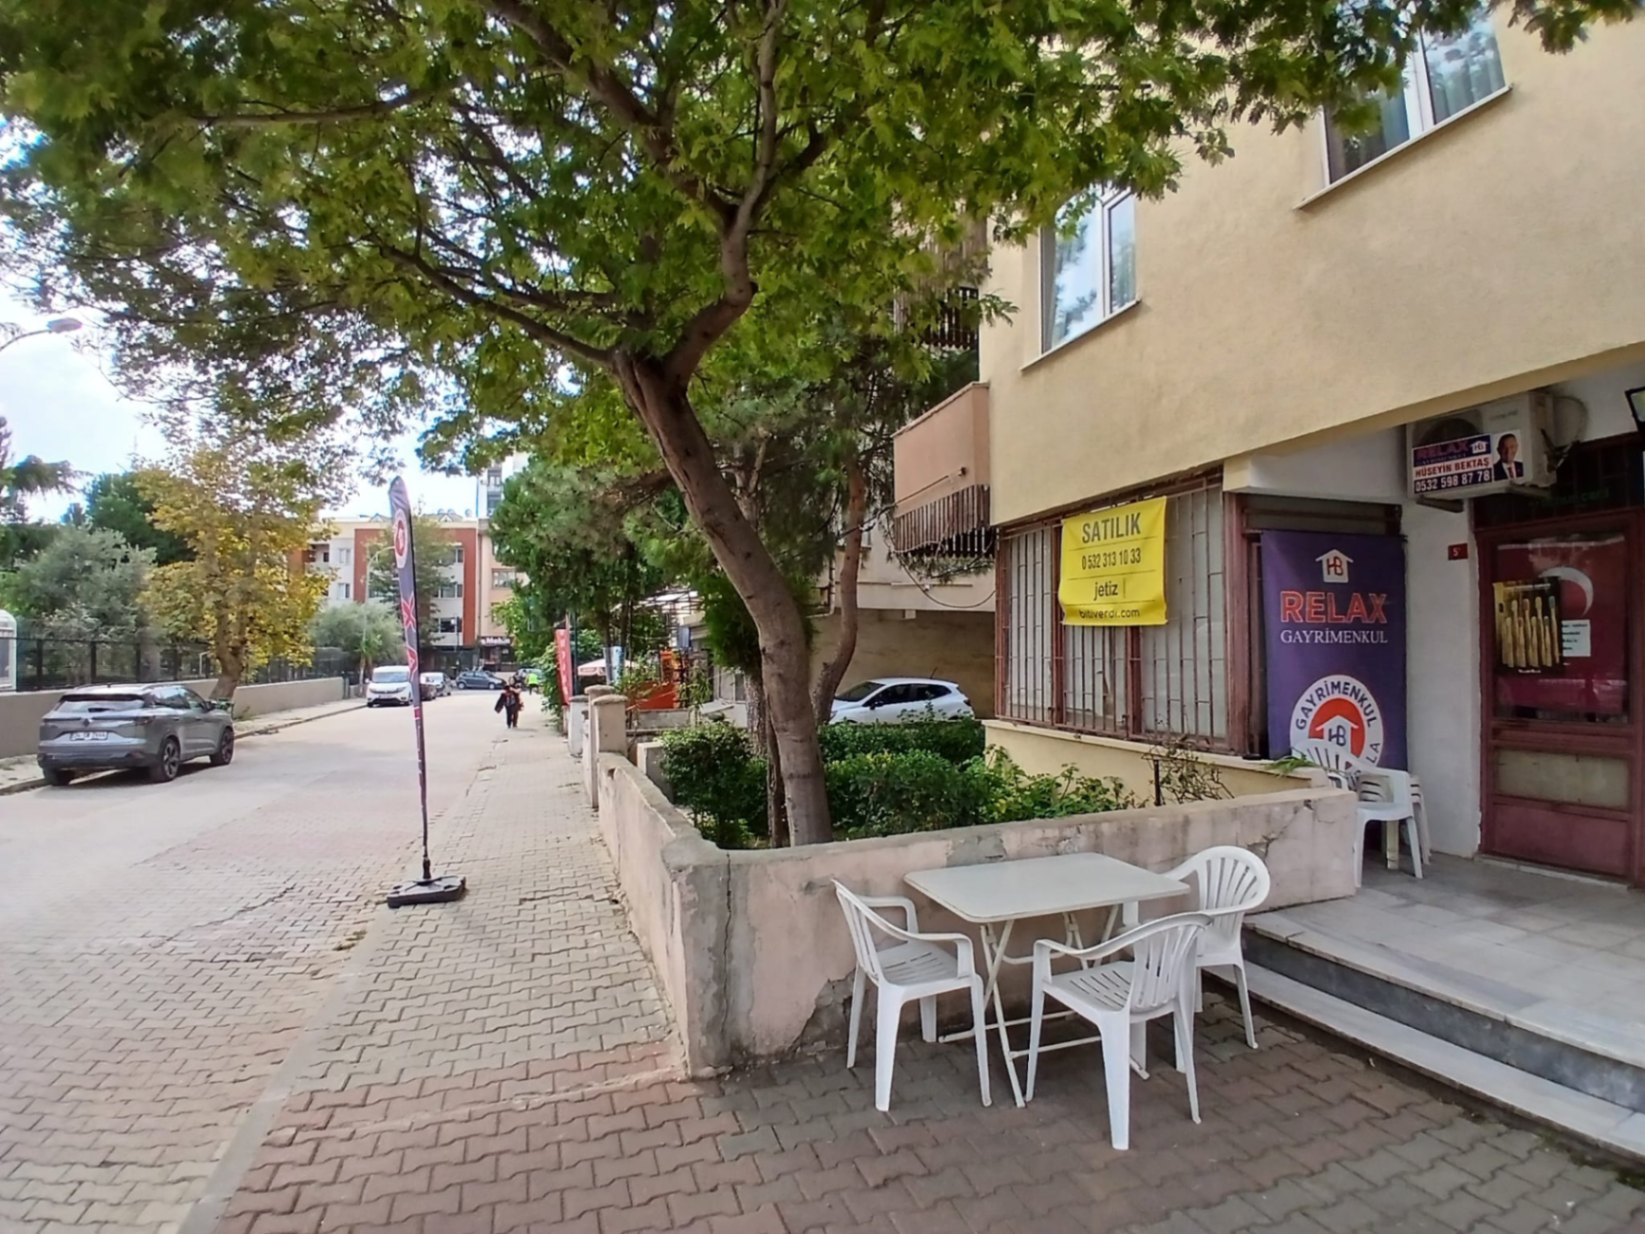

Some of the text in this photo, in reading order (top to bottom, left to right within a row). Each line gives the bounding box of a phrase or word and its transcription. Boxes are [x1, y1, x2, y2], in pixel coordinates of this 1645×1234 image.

[1455, 458, 1490, 471] BEKTAŞ
[1416, 470, 1490, 493] 0532 598 87 78
[1082, 512, 1141, 543] SATILIK
[1082, 547, 1141, 570] 0 532 313 10 33
[1093, 581, 1118, 601] jetiz
[1280, 591, 1388, 623] RELAX
[1280, 627, 1388, 644] GAYRİMENKUL
[1296, 680, 1377, 730] GAYRİMENKUL
